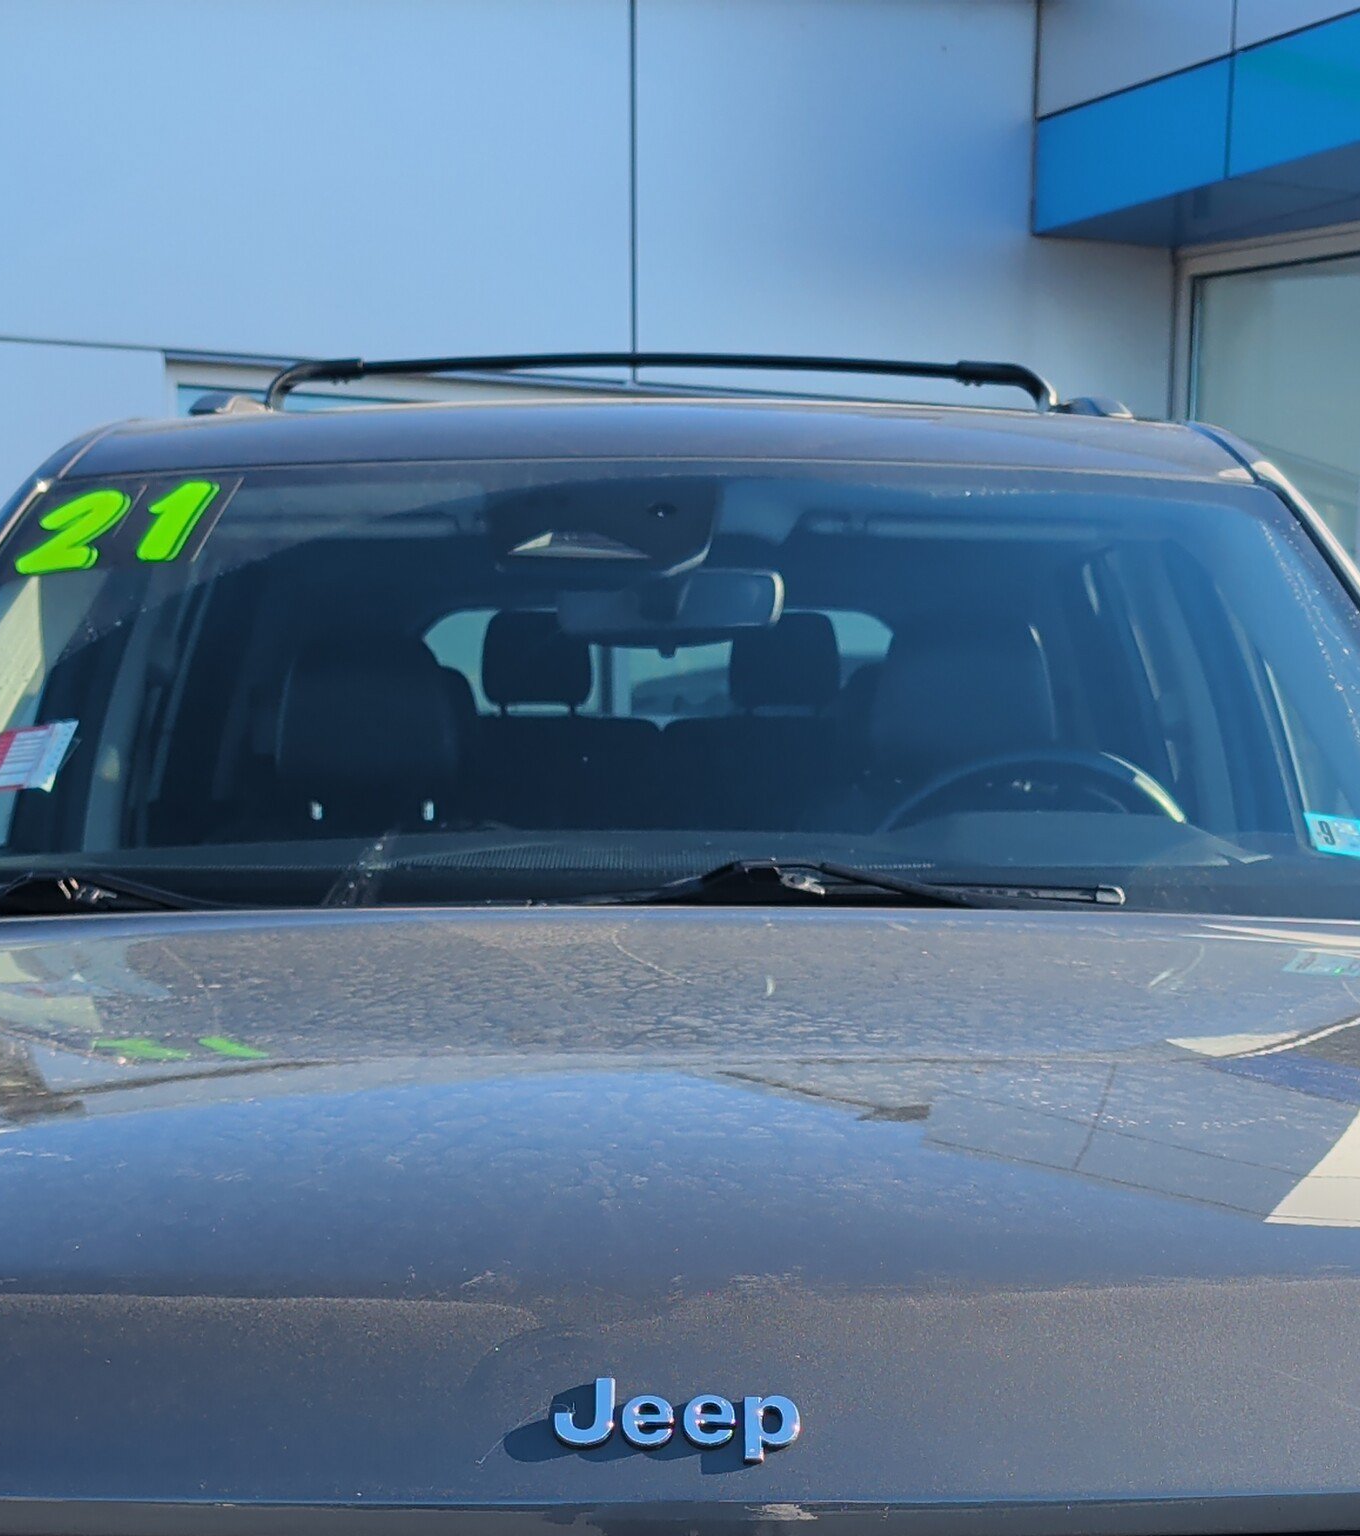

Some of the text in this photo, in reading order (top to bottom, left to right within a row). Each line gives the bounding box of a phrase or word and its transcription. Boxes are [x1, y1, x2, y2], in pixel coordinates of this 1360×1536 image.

[14, 481, 220, 574] 21
[1318, 820, 1336, 846] 9
[554, 1377, 800, 1463] Jeep
